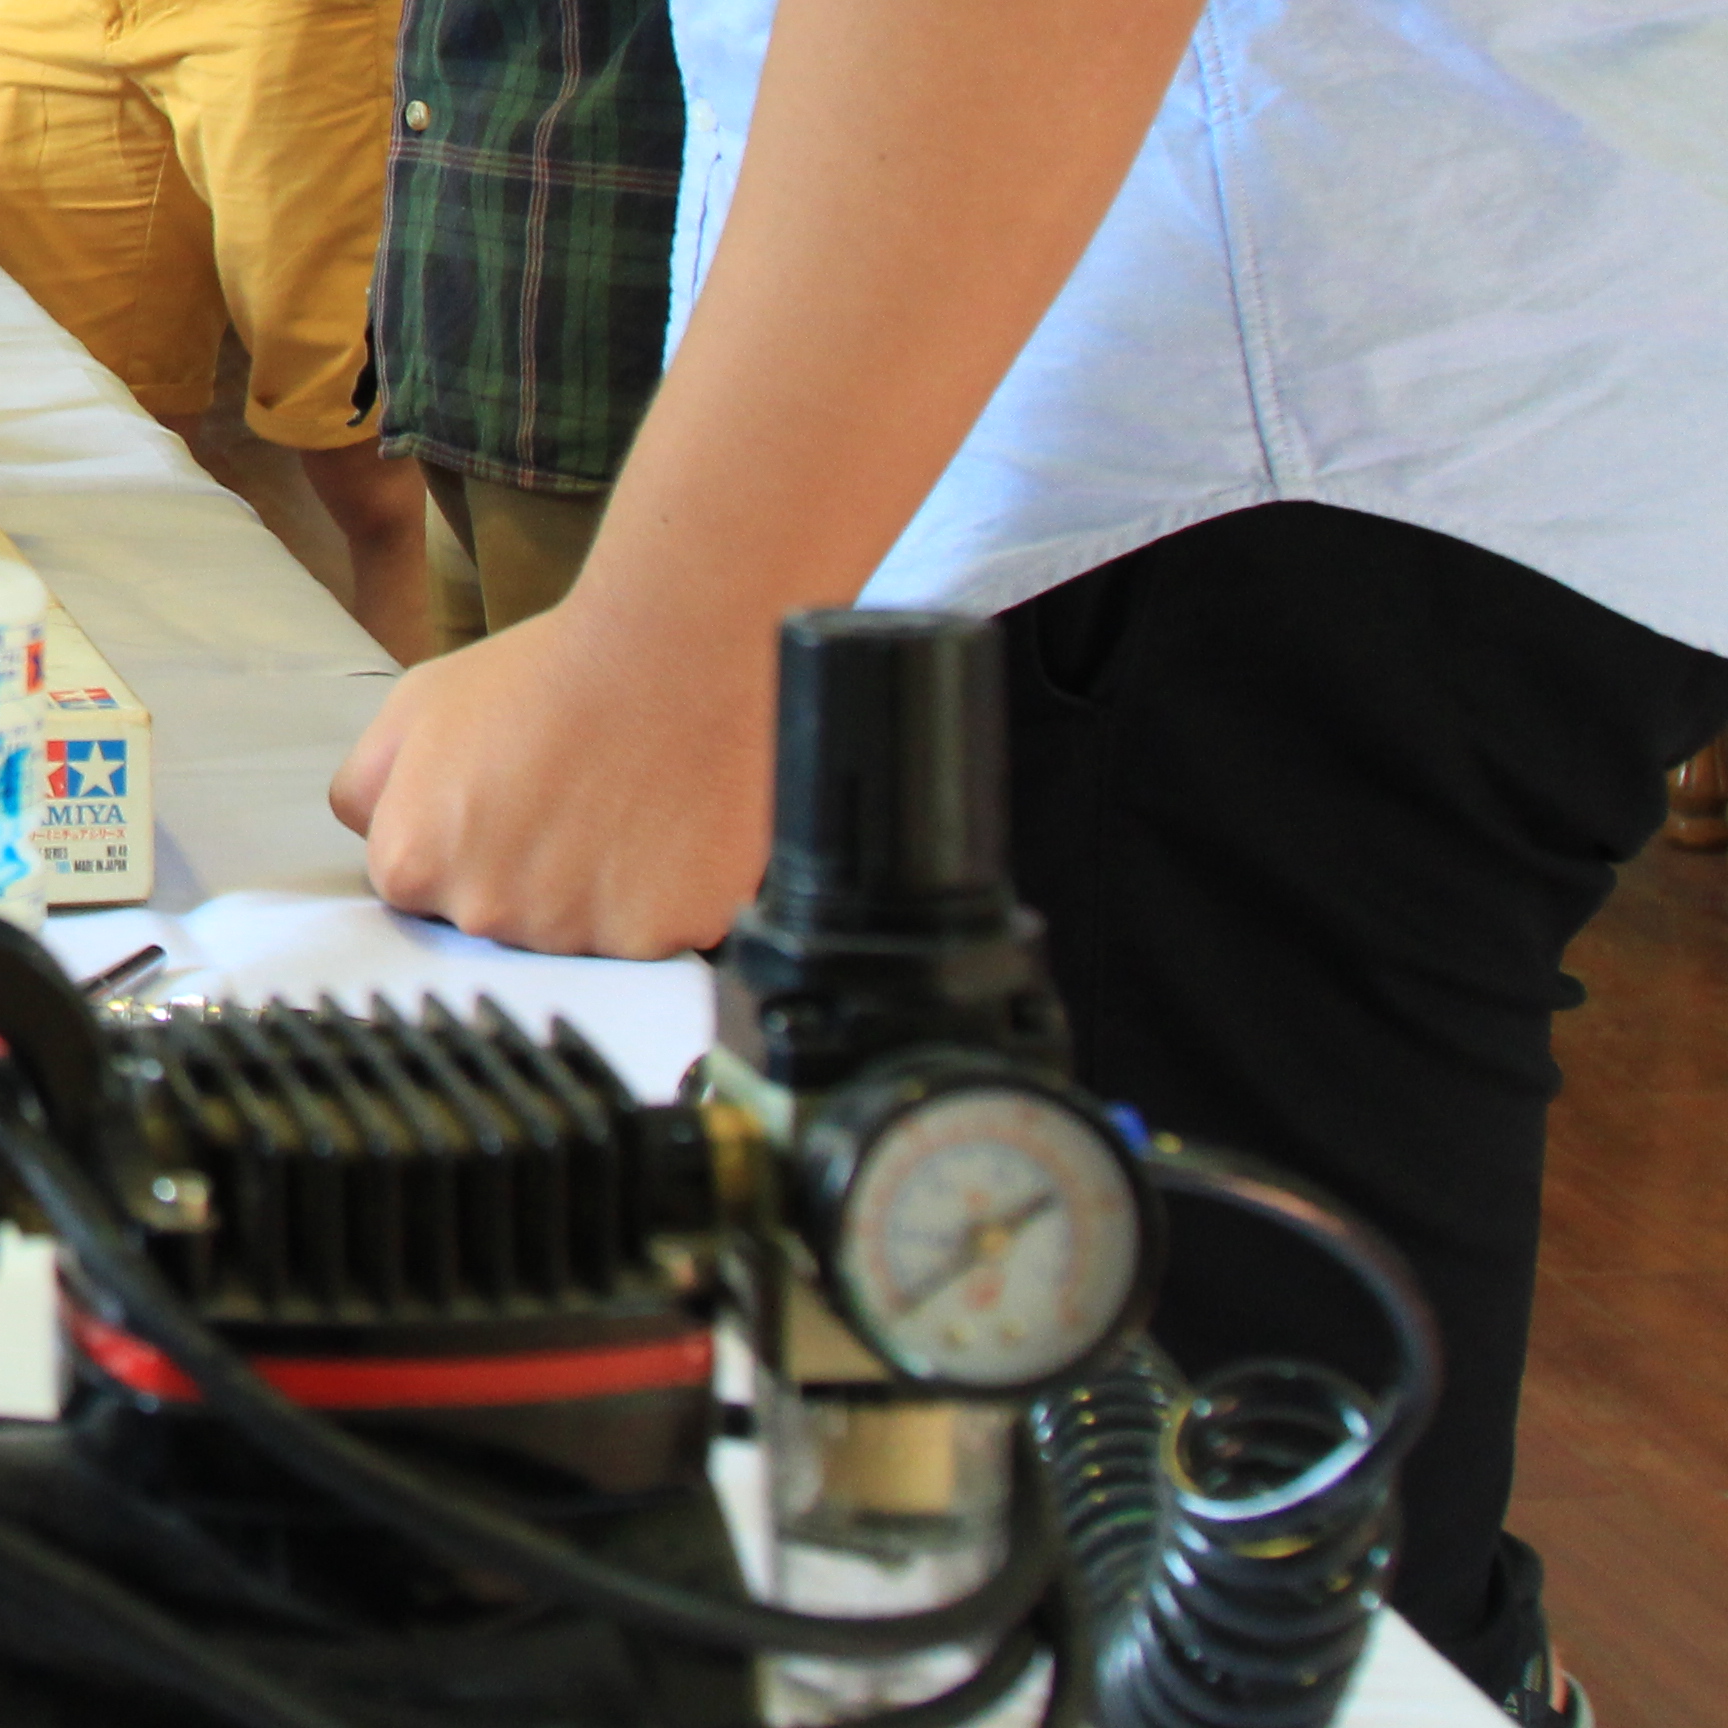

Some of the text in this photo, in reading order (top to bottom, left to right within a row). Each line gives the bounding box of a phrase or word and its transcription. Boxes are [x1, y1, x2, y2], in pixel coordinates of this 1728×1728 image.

[41, 803, 127, 826] MIYA
[74, 860, 94, 873] MADE
[95, 860, 103, 872] IN
[103, 859, 127, 872] JAPAN
